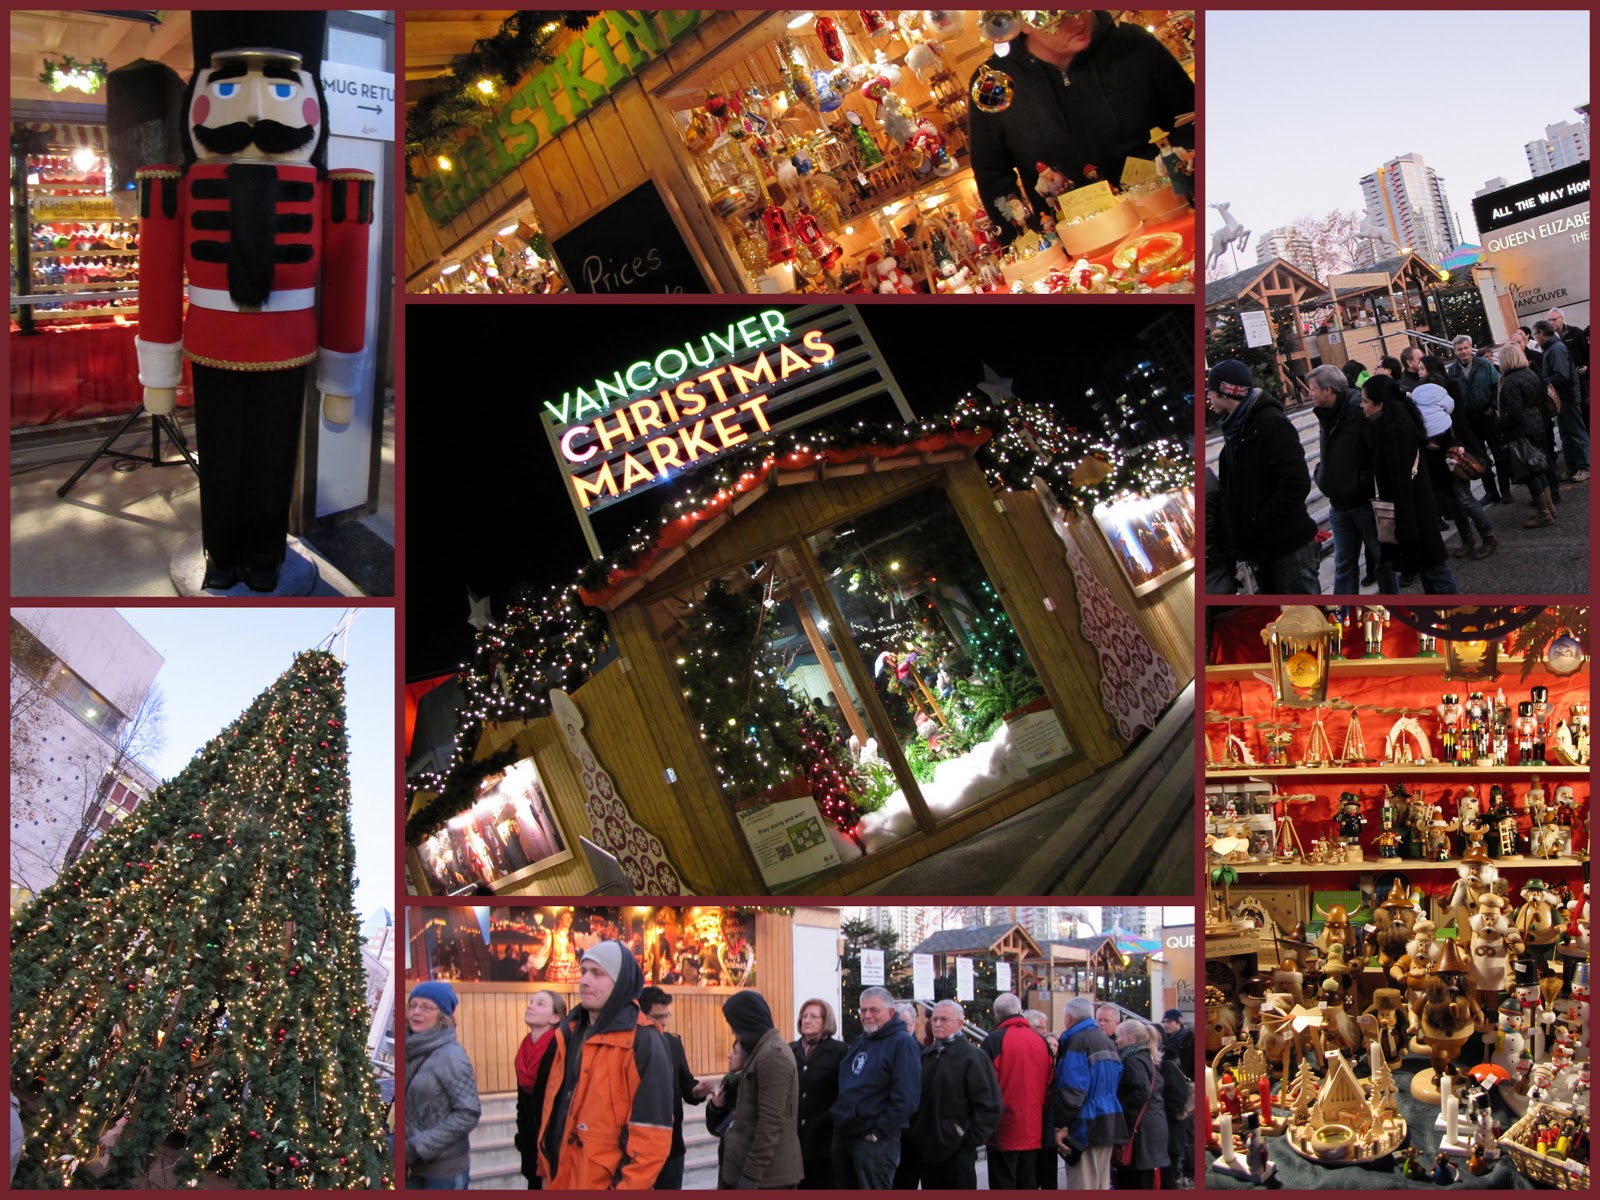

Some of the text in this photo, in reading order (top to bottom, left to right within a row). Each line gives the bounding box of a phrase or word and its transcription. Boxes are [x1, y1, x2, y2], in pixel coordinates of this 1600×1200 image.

[323, 78, 395, 102] MUG RETU
[1492, 206, 1513, 220] ALL
[1515, 197, 1536, 212] THE
[1538, 188, 1564, 204] WAY
[1488, 211, 1590, 253] QUEEN ELIZABE
[1570, 230, 1590, 244] THE
[583, 248, 661, 294] Prices
[1518, 287, 1542, 299] CITY OF
[543, 309, 791, 425] VANCOUVER
[560, 330, 836, 464] CHRISTMAS
[570, 394, 772, 509] MARKET
[757, 826, 770, 835] Play
[784, 815, 794, 823] and
[794, 810, 806, 820] win!
[1166, 934, 1195, 949] QUE
